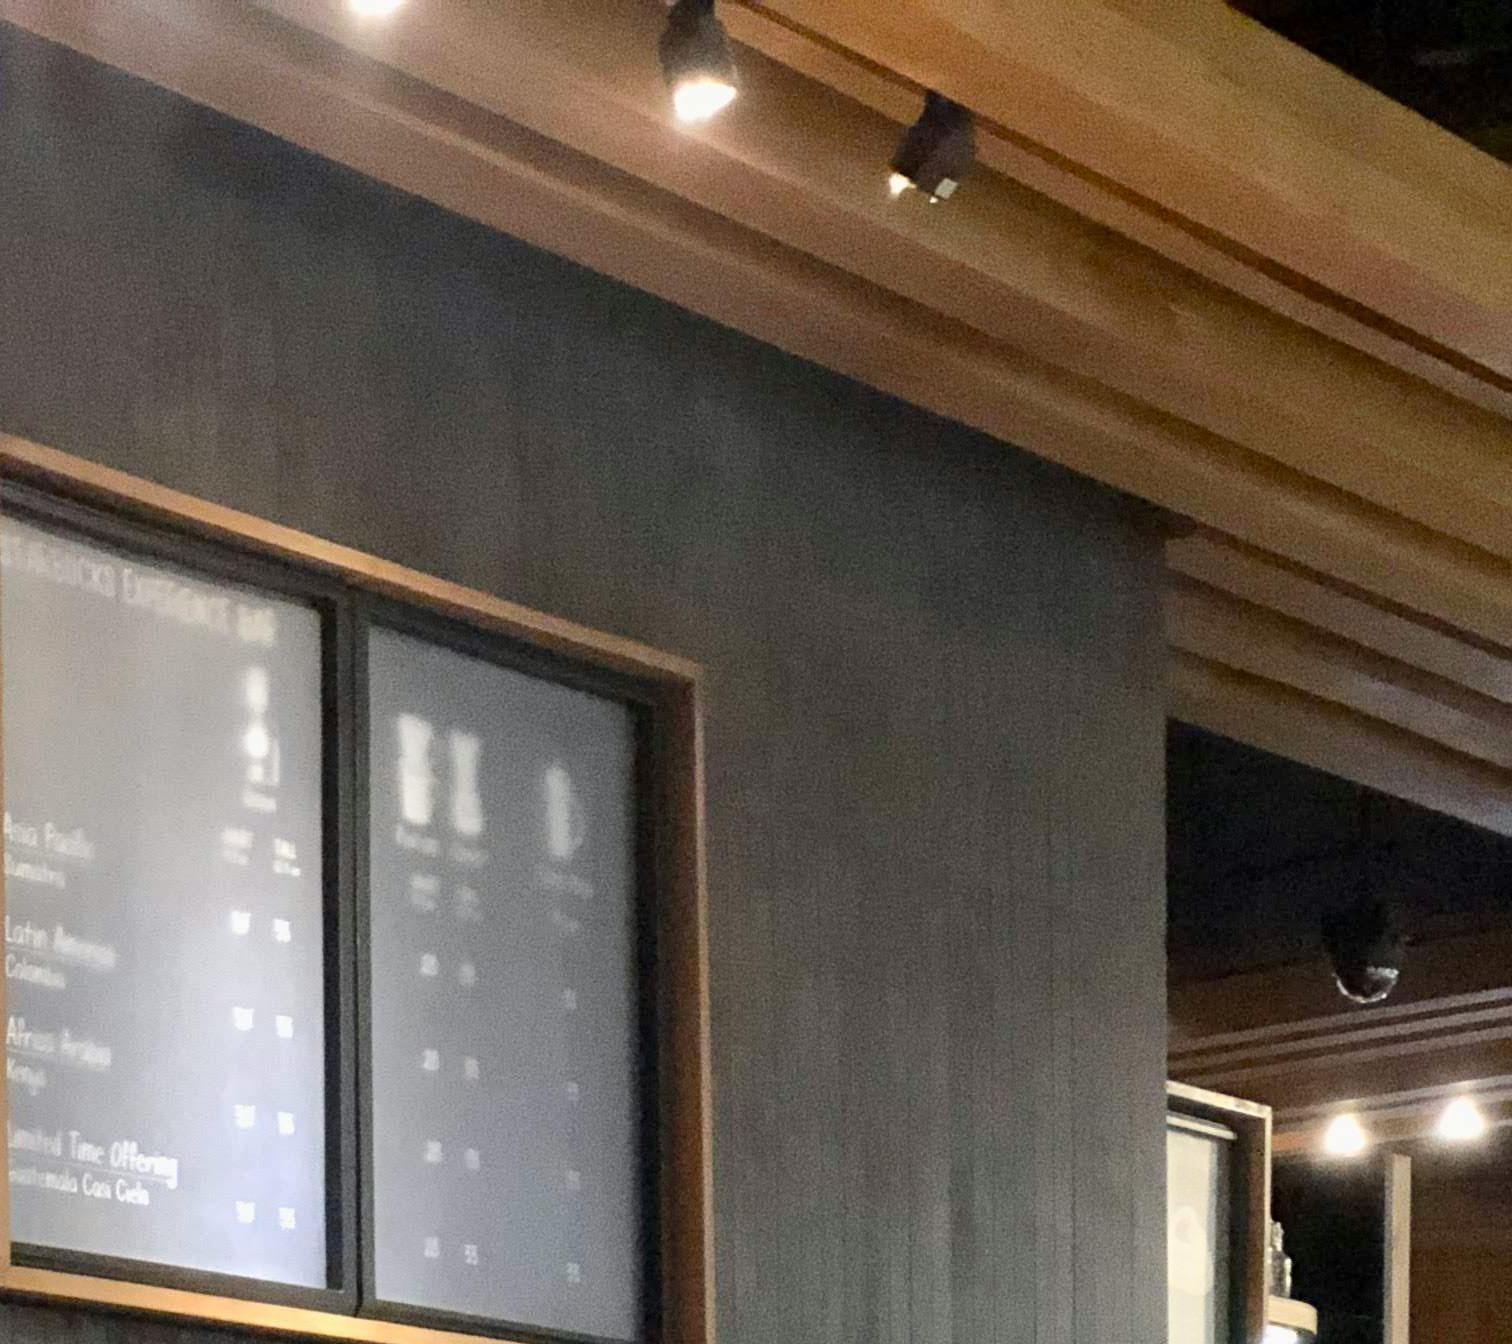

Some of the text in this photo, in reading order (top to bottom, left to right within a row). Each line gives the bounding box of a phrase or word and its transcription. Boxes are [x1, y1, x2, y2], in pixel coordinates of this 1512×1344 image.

[4, 913, 49, 949] Latin
[68, 1130, 105, 1165] Time
[109, 1140, 179, 1190] Offering
